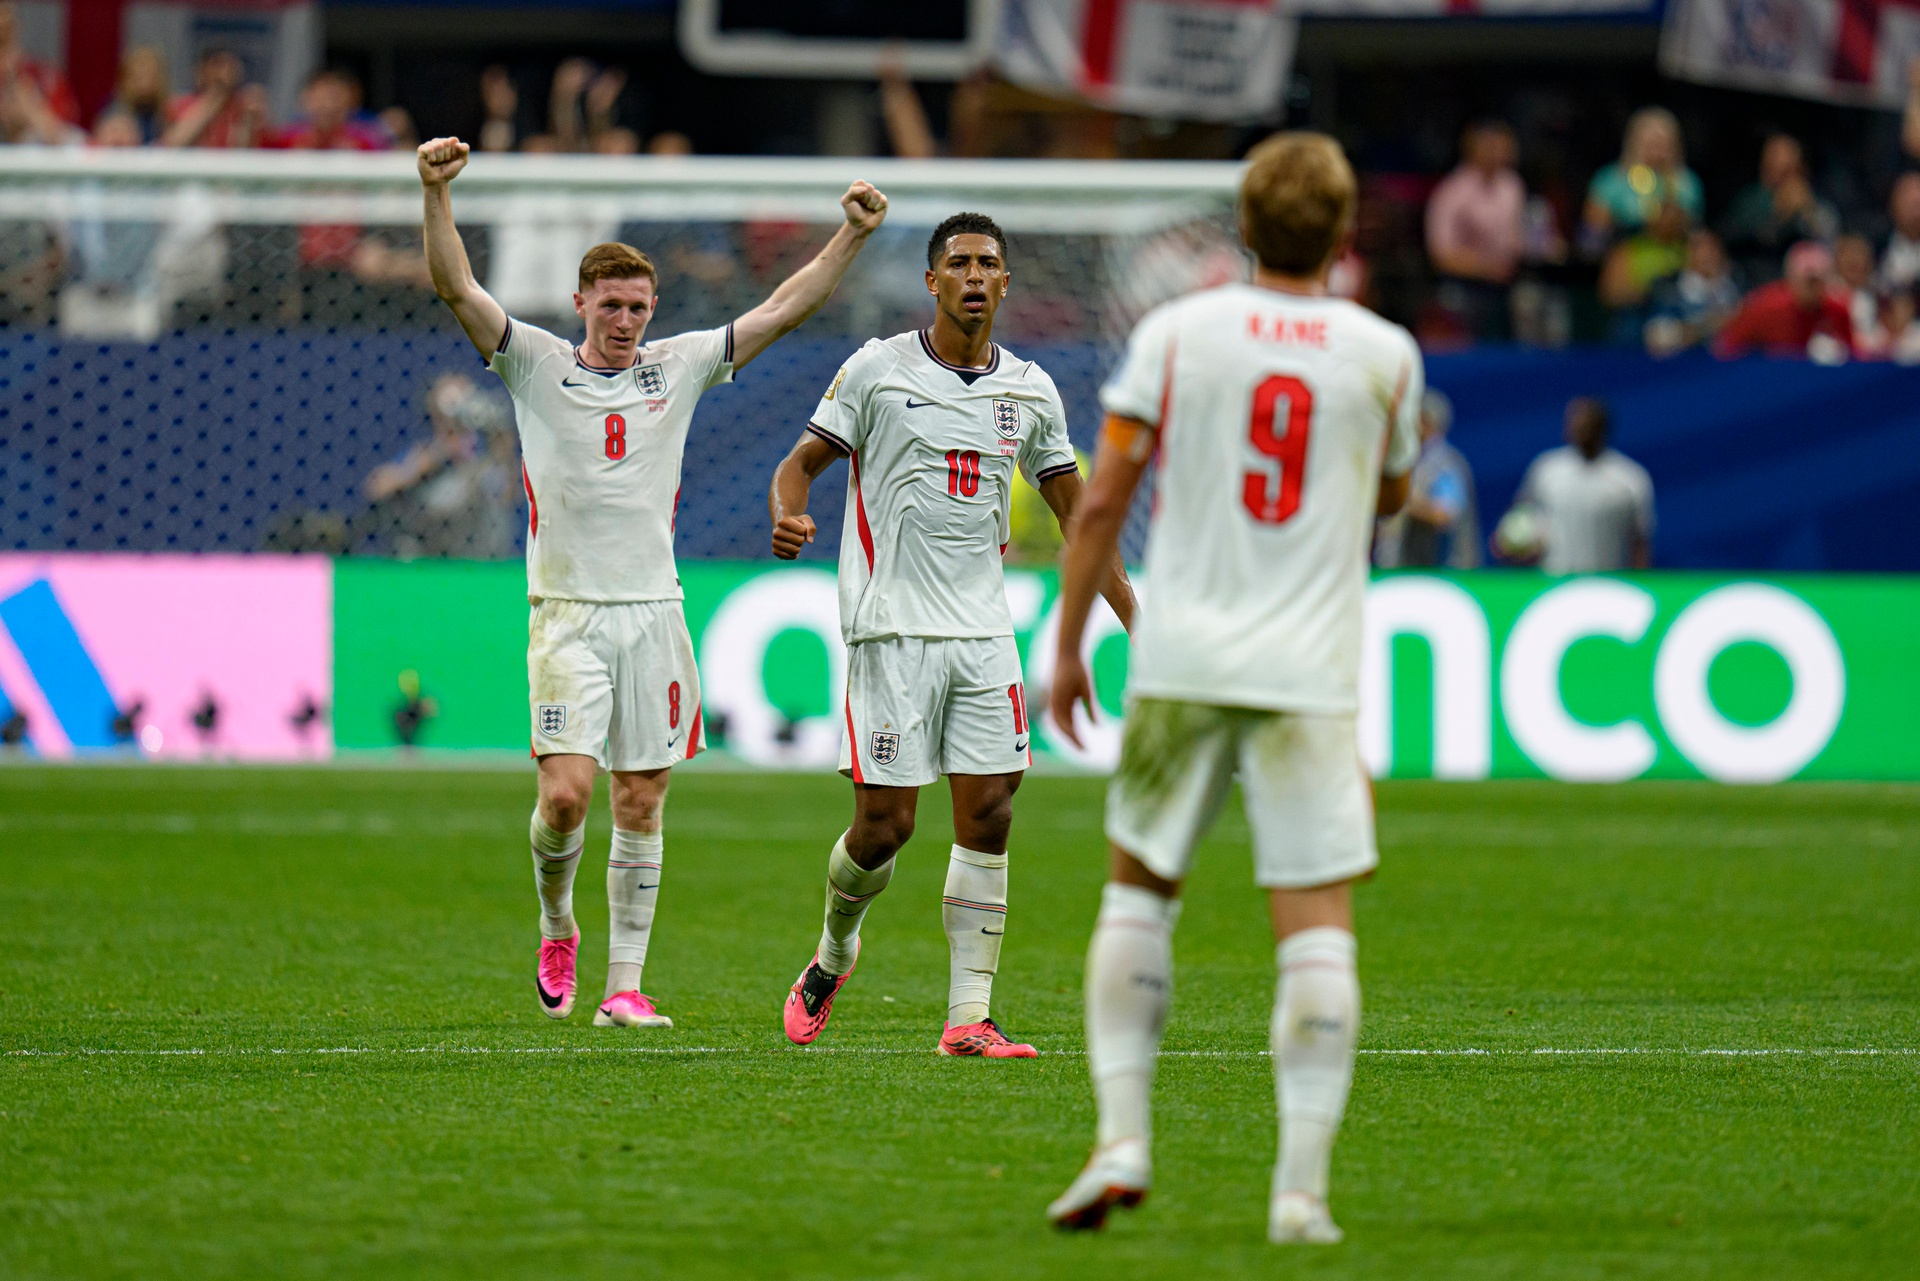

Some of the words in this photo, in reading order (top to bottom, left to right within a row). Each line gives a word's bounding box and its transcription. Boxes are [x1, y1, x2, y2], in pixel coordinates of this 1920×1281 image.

[1246, 312, 1329, 348] KANE
[605, 413, 626, 461] 8
[1241, 374, 1313, 525] 9
[945, 449, 981, 498] 10
[701, 568, 1845, 785] aco
[667, 680, 681, 730] 8
